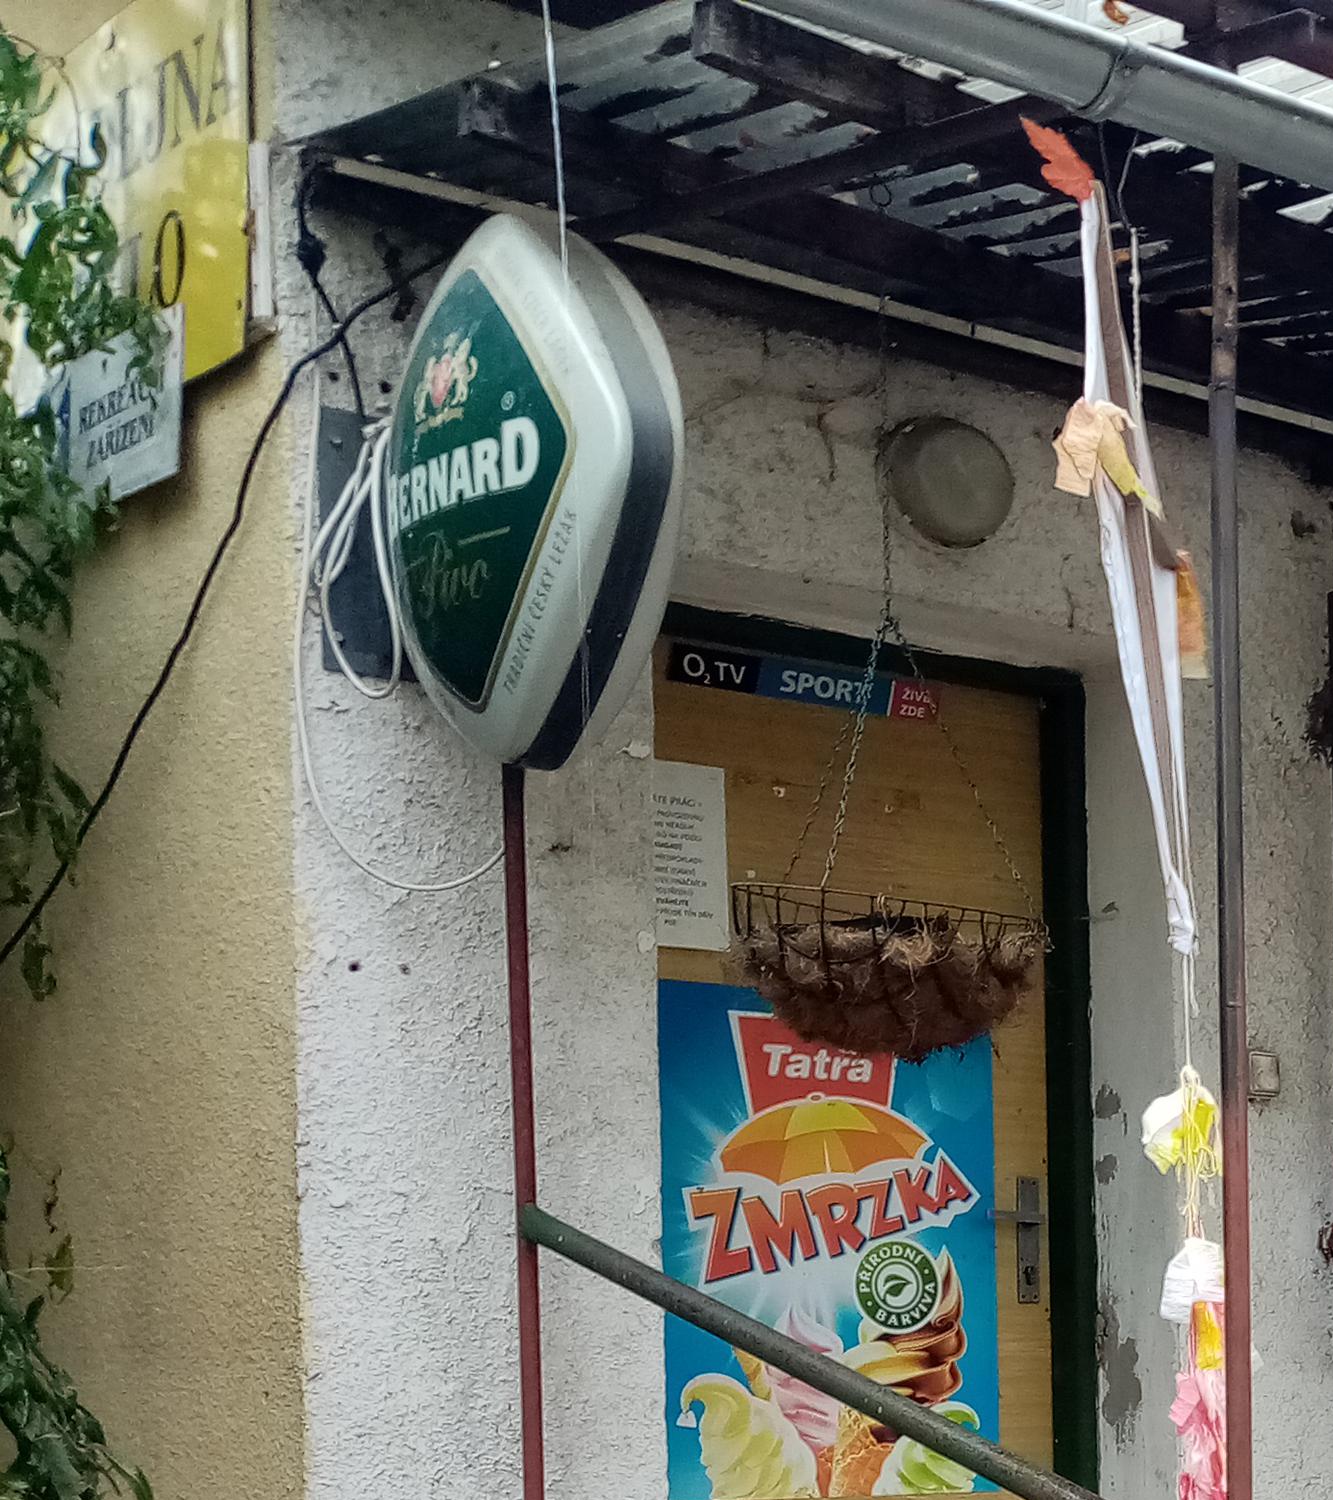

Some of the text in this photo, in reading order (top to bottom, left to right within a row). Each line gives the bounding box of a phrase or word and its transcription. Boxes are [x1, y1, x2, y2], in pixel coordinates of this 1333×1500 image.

[389, 415, 541, 541] BERNARD
[714, 660, 746, 684] TV
[899, 703, 925, 719] ZDE
[762, 1043, 875, 1084] Tatra
[686, 1156, 973, 1285] ZMRZKA
[858, 1241, 923, 1294] PŘÍRODNÍ
[874, 1280, 938, 1328] BARVIVA
